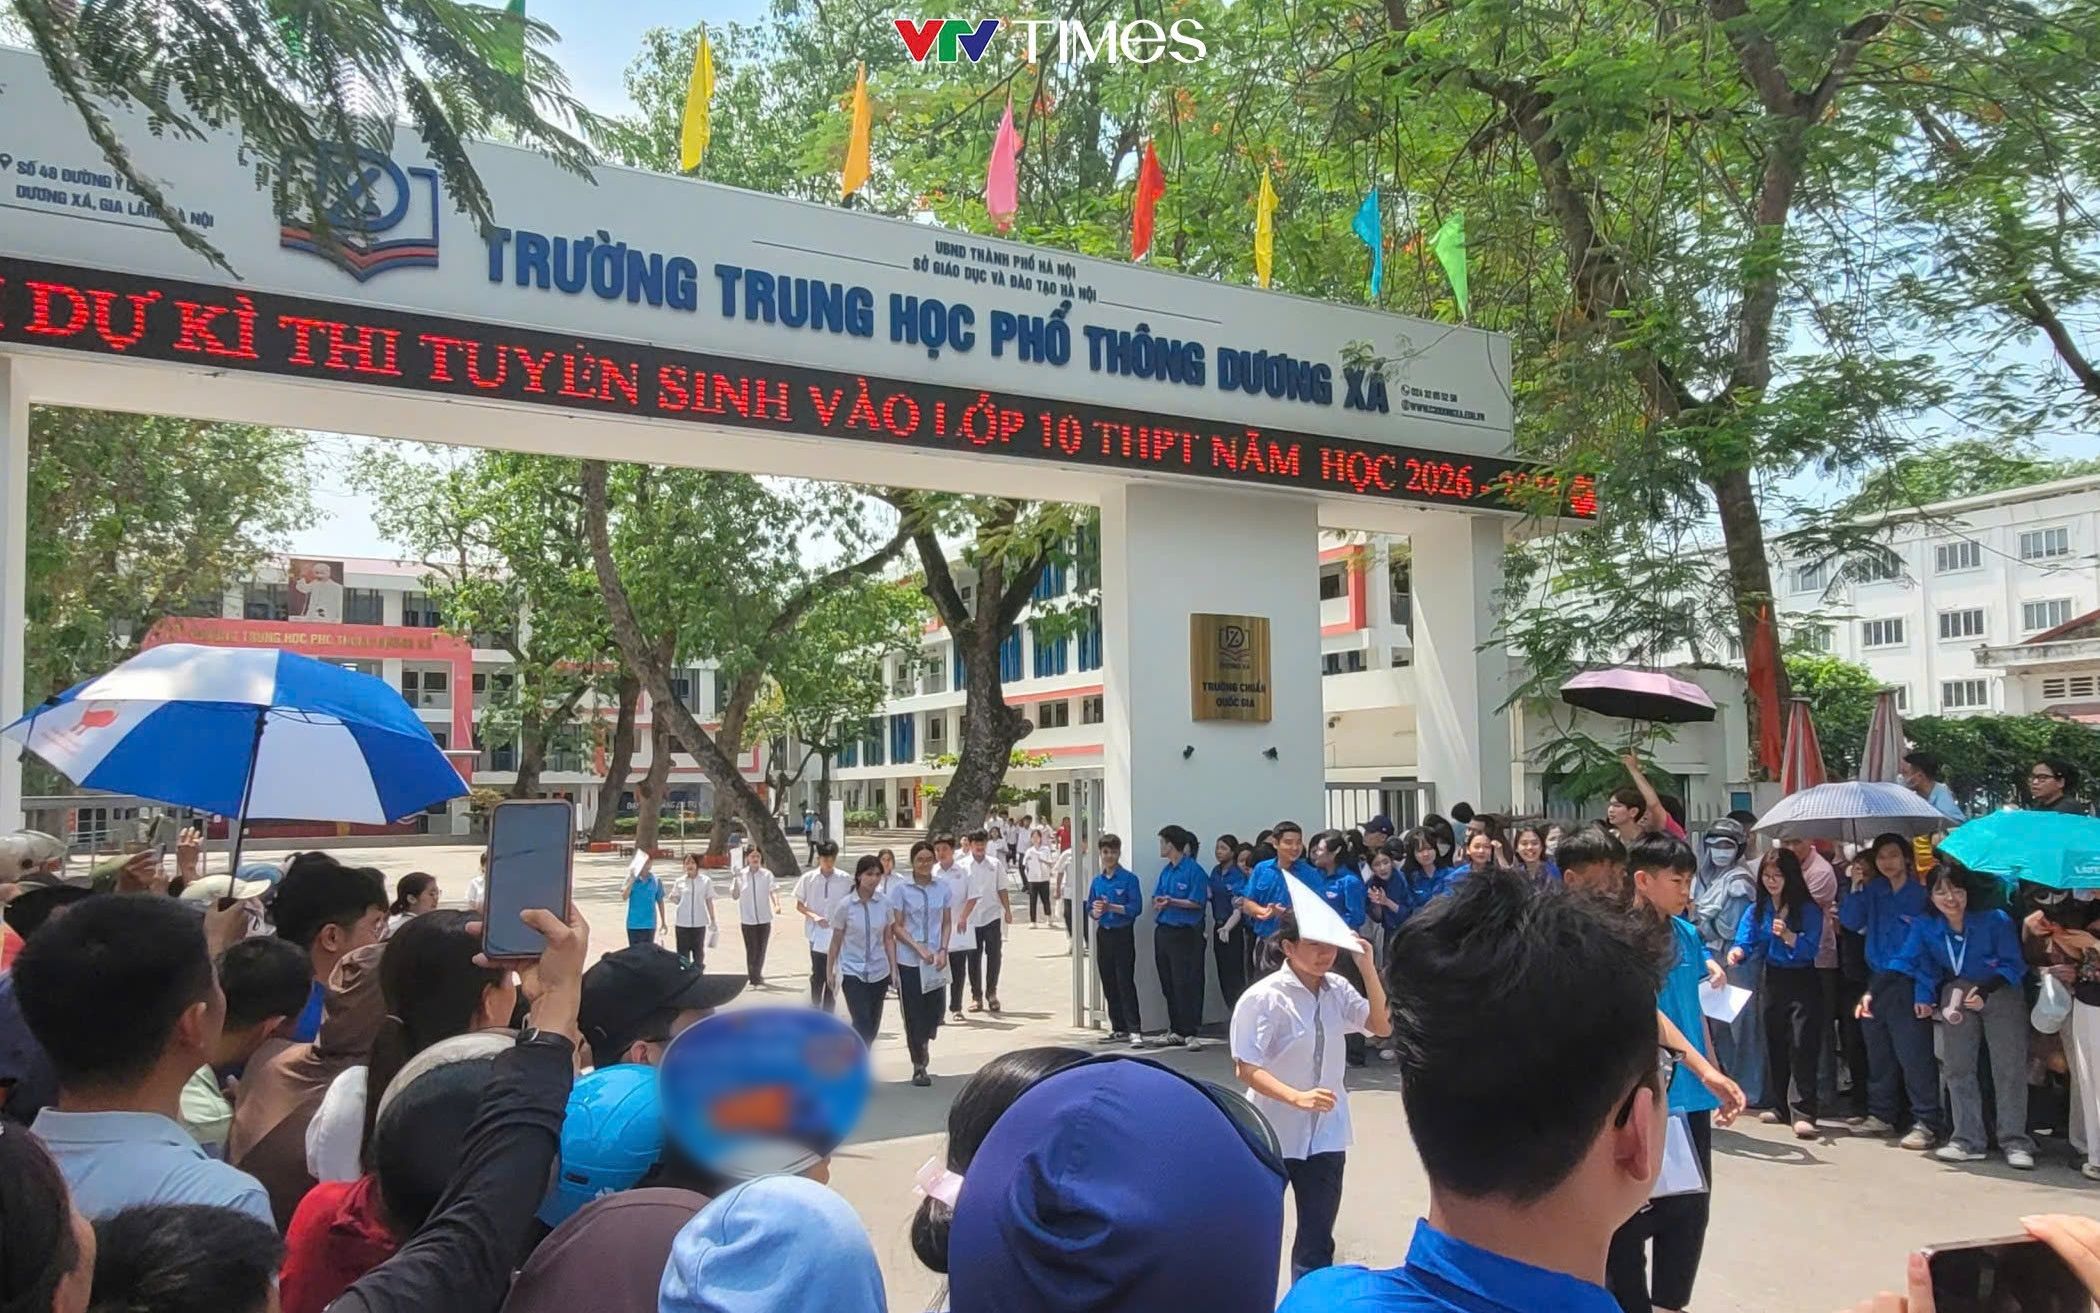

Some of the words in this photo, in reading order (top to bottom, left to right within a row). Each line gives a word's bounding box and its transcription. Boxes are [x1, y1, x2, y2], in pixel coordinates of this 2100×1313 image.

[99, 197, 123, 214] GIA
[190, 210, 214, 229] NỘI
[913, 255, 930, 272] SỞ
[932, 261, 960, 279] GIÁO
[964, 266, 987, 284] DỤC
[991, 271, 1006, 287] VÀ
[1010, 274, 1033, 291] ĐÀO
[1037, 280, 1057, 297] TẠO
[1060, 283, 1075, 299] HÀ
[1078, 286, 1097, 304] NỘI
[935, 240, 967, 259] UBND
[970, 247, 1010, 267] THÀNH
[1013, 253, 1036, 272] PHỐ
[1038, 259, 1054, 275] HÀ
[1057, 262, 1077, 281] NỘI
[484, 228, 698, 313] TRƯỜNG
[714, 263, 875, 338] TRUNG
[890, 293, 976, 360] HỌC
[990, 300, 1073, 367] PHỔ
[1083, 322, 1206, 387] THÔNG
[1217, 347, 1333, 406] DƯƠNG
[24, 281, 163, 351] DỰ
[173, 295, 259, 359] KÌ
[278, 315, 402, 376] THI
[657, 365, 792, 422] SINH
[808, 377, 921, 437] VÀO
[1039, 412, 1083, 455] 10
[1093, 420, 1200, 464] THPT
[1211, 430, 1301, 477] NĂM
[1319, 447, 1397, 493] HỌC
[1405, 458, 1473, 499] 2026
